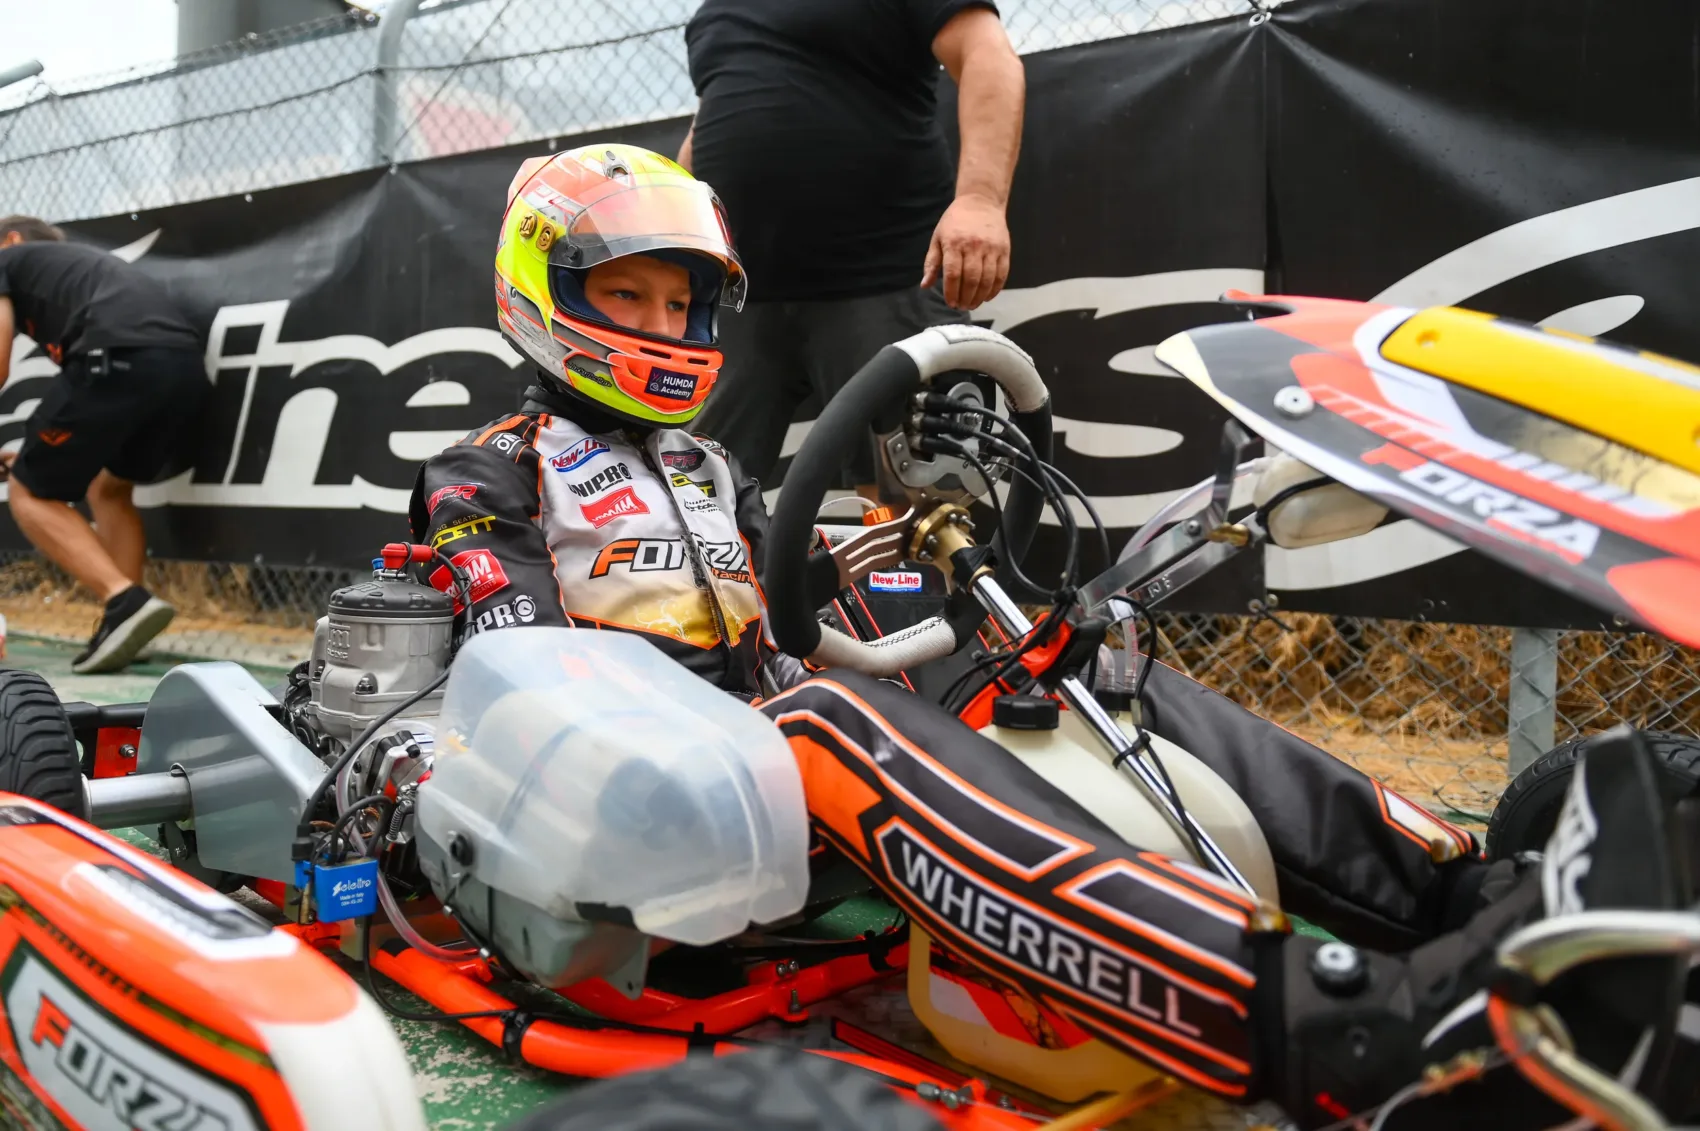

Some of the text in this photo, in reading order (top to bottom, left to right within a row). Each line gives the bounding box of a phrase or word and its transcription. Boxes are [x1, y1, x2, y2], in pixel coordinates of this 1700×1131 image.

[663, 375, 694, 389] HUMDA
[660, 386, 692, 398] Academy
[711, 567, 753, 586] Racin
[872, 573, 920, 585] New-Line
[901, 840, 1202, 1037] WHERRELL
